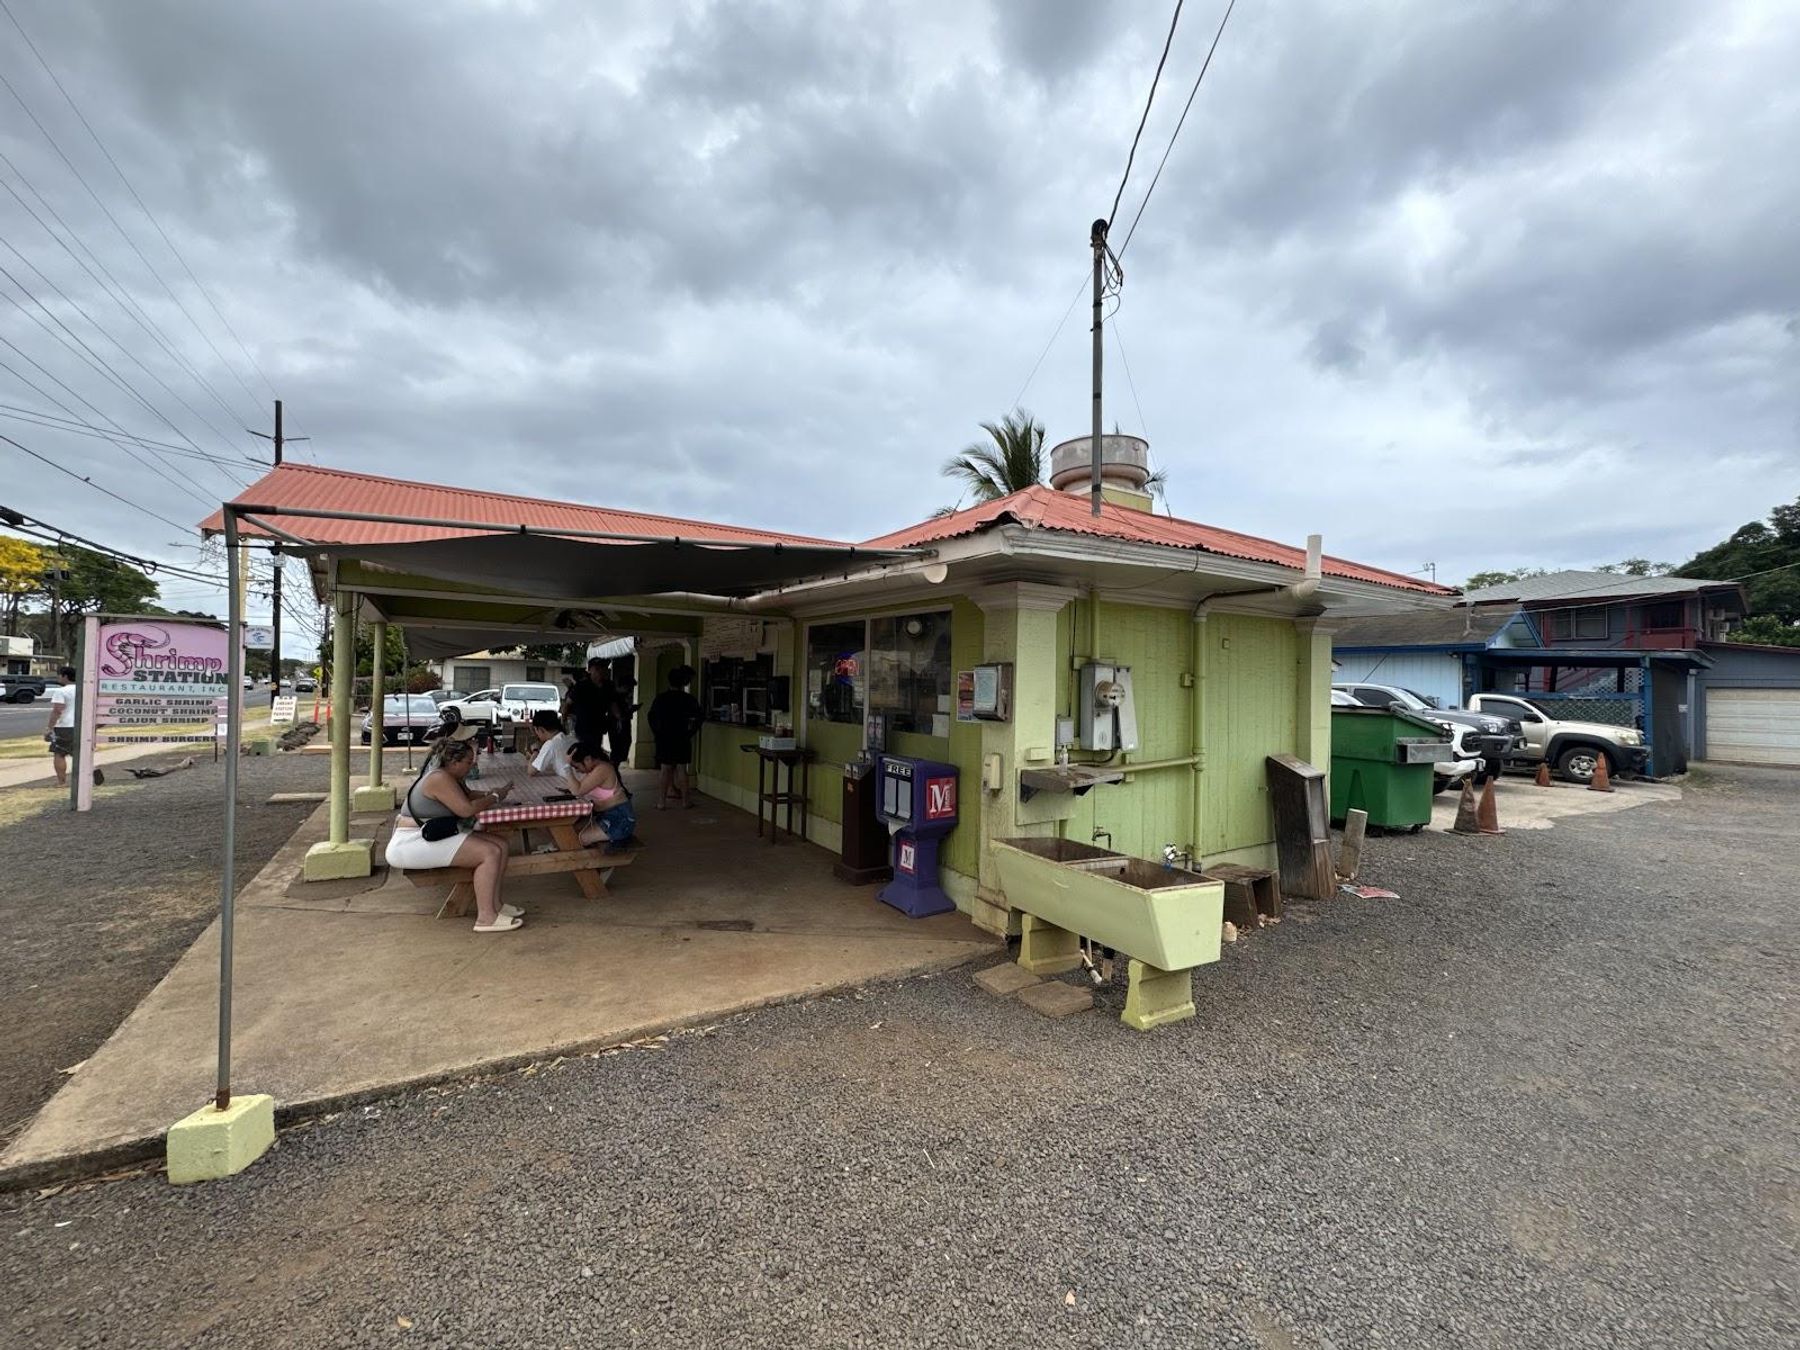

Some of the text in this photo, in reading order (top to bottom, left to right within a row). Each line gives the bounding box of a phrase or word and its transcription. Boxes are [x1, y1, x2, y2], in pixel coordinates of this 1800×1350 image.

[101, 632, 222, 677] Shrimp
[133, 670, 228, 684] STATION
[101, 683, 195, 693] RESTAURANT,
[108, 707, 168, 715] COCONUT
[886, 762, 912, 778] FREE
